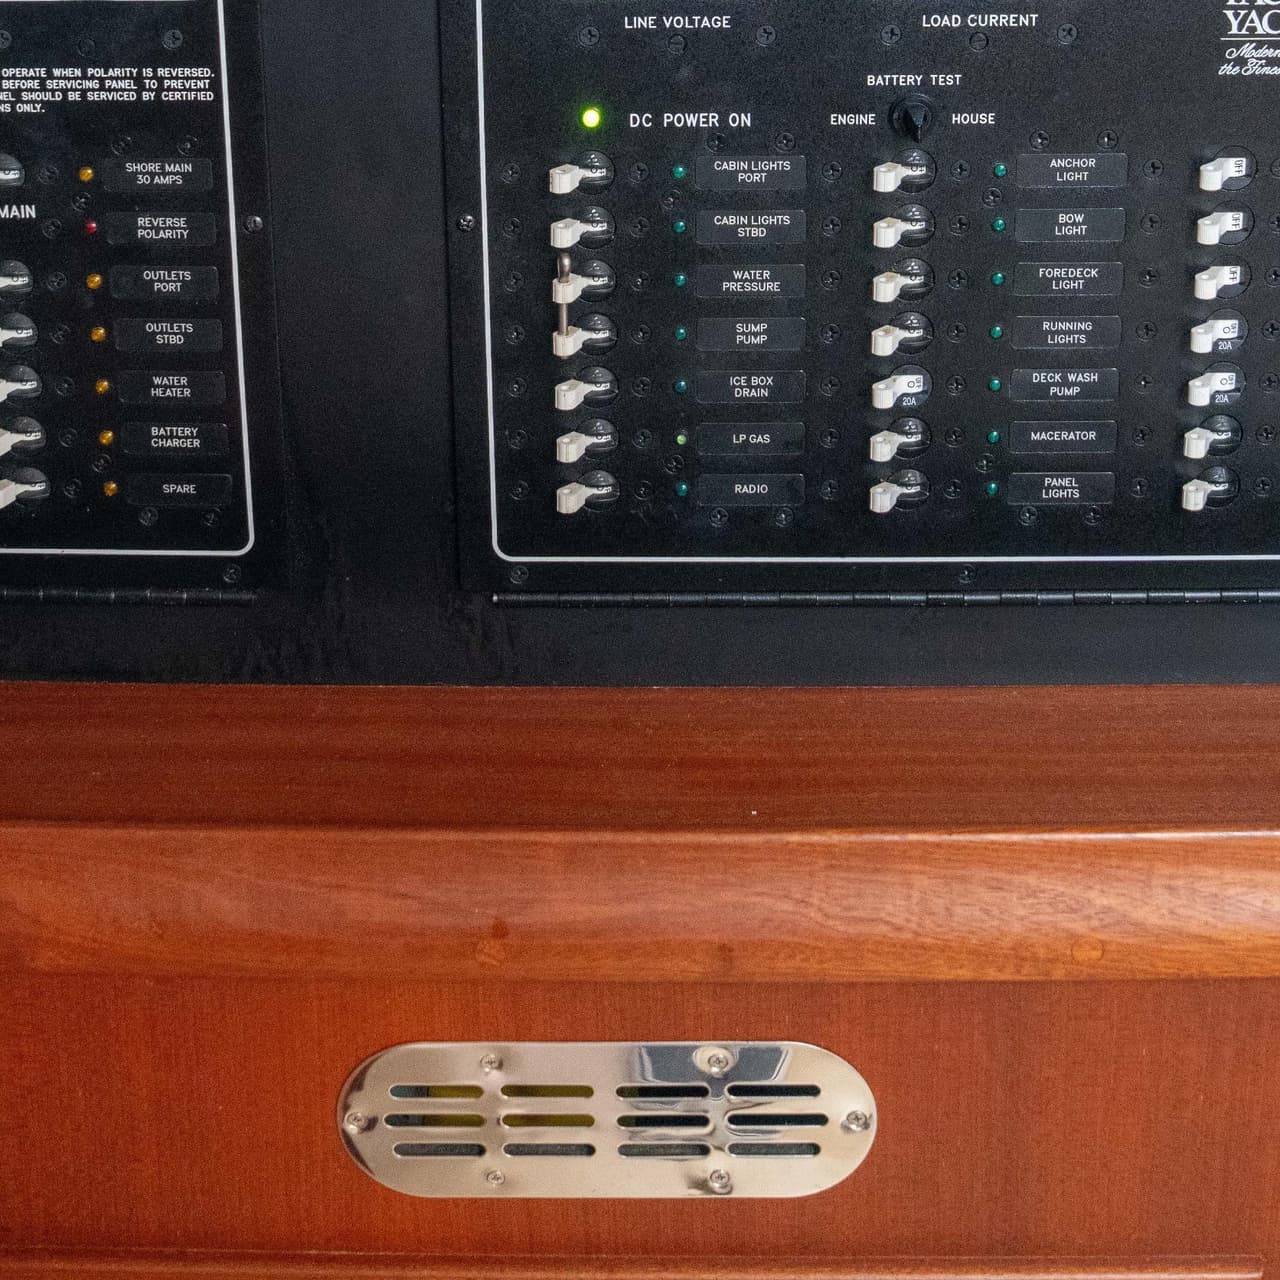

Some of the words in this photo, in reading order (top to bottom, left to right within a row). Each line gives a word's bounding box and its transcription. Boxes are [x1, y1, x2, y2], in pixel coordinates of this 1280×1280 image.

[625, 17, 657, 29] LINE
[662, 16, 731, 28] VOLTAGE
[923, 15, 961, 27] LOAD
[968, 14, 1038, 27] CURRENT
[1218, 62, 1240, 75] the
[2, 80, 40, 89] BEFORE
[46, 80, 99, 88] SERVICING
[105, 80, 137, 88] PANEL
[145, 80, 157, 88] TO
[164, 80, 210, 88] PREVENT
[867, 75, 923, 86] BATTERY
[931, 74, 962, 85] TEST
[17, 104, 45, 113] ONLY.
[630, 114, 652, 127] DC
[664, 114, 719, 127] POWER
[729, 113, 751, 127] ON
[831, 114, 875, 125] ENGINE
[952, 113, 995, 124] HOUSE
[126, 163, 160, 172] SHORE
[165, 163, 192, 172] MAIN
[714, 161, 749, 171] CABIN
[752, 161, 790, 171] LIGHTS
[1050, 159, 1095, 168] ANCHOR
[137, 175, 149, 184] 30
[153, 175, 183, 184] AMPS
[738, 173, 767, 183] PORT
[1057, 172, 1088, 181] LIGHT
[138, 218, 187, 227] REVERSE
[714, 216, 749, 225] CABIN
[752, 216, 790, 225] LIGHTS
[1059, 214, 1084, 223] BOW
[138, 229, 189, 239] POLARITY
[738, 227, 766, 237] STBD
[1056, 225, 1087, 235] LIGHT
[144, 271, 190, 281] OUTLETS
[733, 271, 770, 280] WATER
[1039, 269, 1098, 278] FOREDECK
[155, 282, 181, 292] PORT
[723, 282, 780, 291] PRESSURE
[1053, 280, 1084, 289] LIGHT
[146, 323, 193, 333] OUTLETS
[736, 323, 768, 333] SUMP
[1043, 322, 1092, 331] RUNNING
[156, 335, 184, 344] STBD
[736, 334, 768, 344] PUMP
[1048, 334, 1086, 344] LIGHTS
[153, 377, 187, 386] WATER
[729, 377, 746, 386] ICE
[750, 377, 773, 386] BOX
[1033, 373, 1062, 383] DECK
[1068, 373, 1098, 383] WASH
[151, 387, 190, 397] HEATER
[735, 388, 768, 397] DRAIN
[1050, 386, 1080, 396] PUMP
[151, 427, 197, 437] BATTERY
[1031, 431, 1095, 441] MACERATOR
[152, 438, 200, 447] CHARGER
[733, 434, 745, 443] LP
[749, 434, 770, 443] GAS
[1045, 478, 1078, 487] PANEL
[163, 484, 196, 493] SPARE
[735, 484, 768, 494] RADIO
[1042, 489, 1079, 498] LIGHTS
